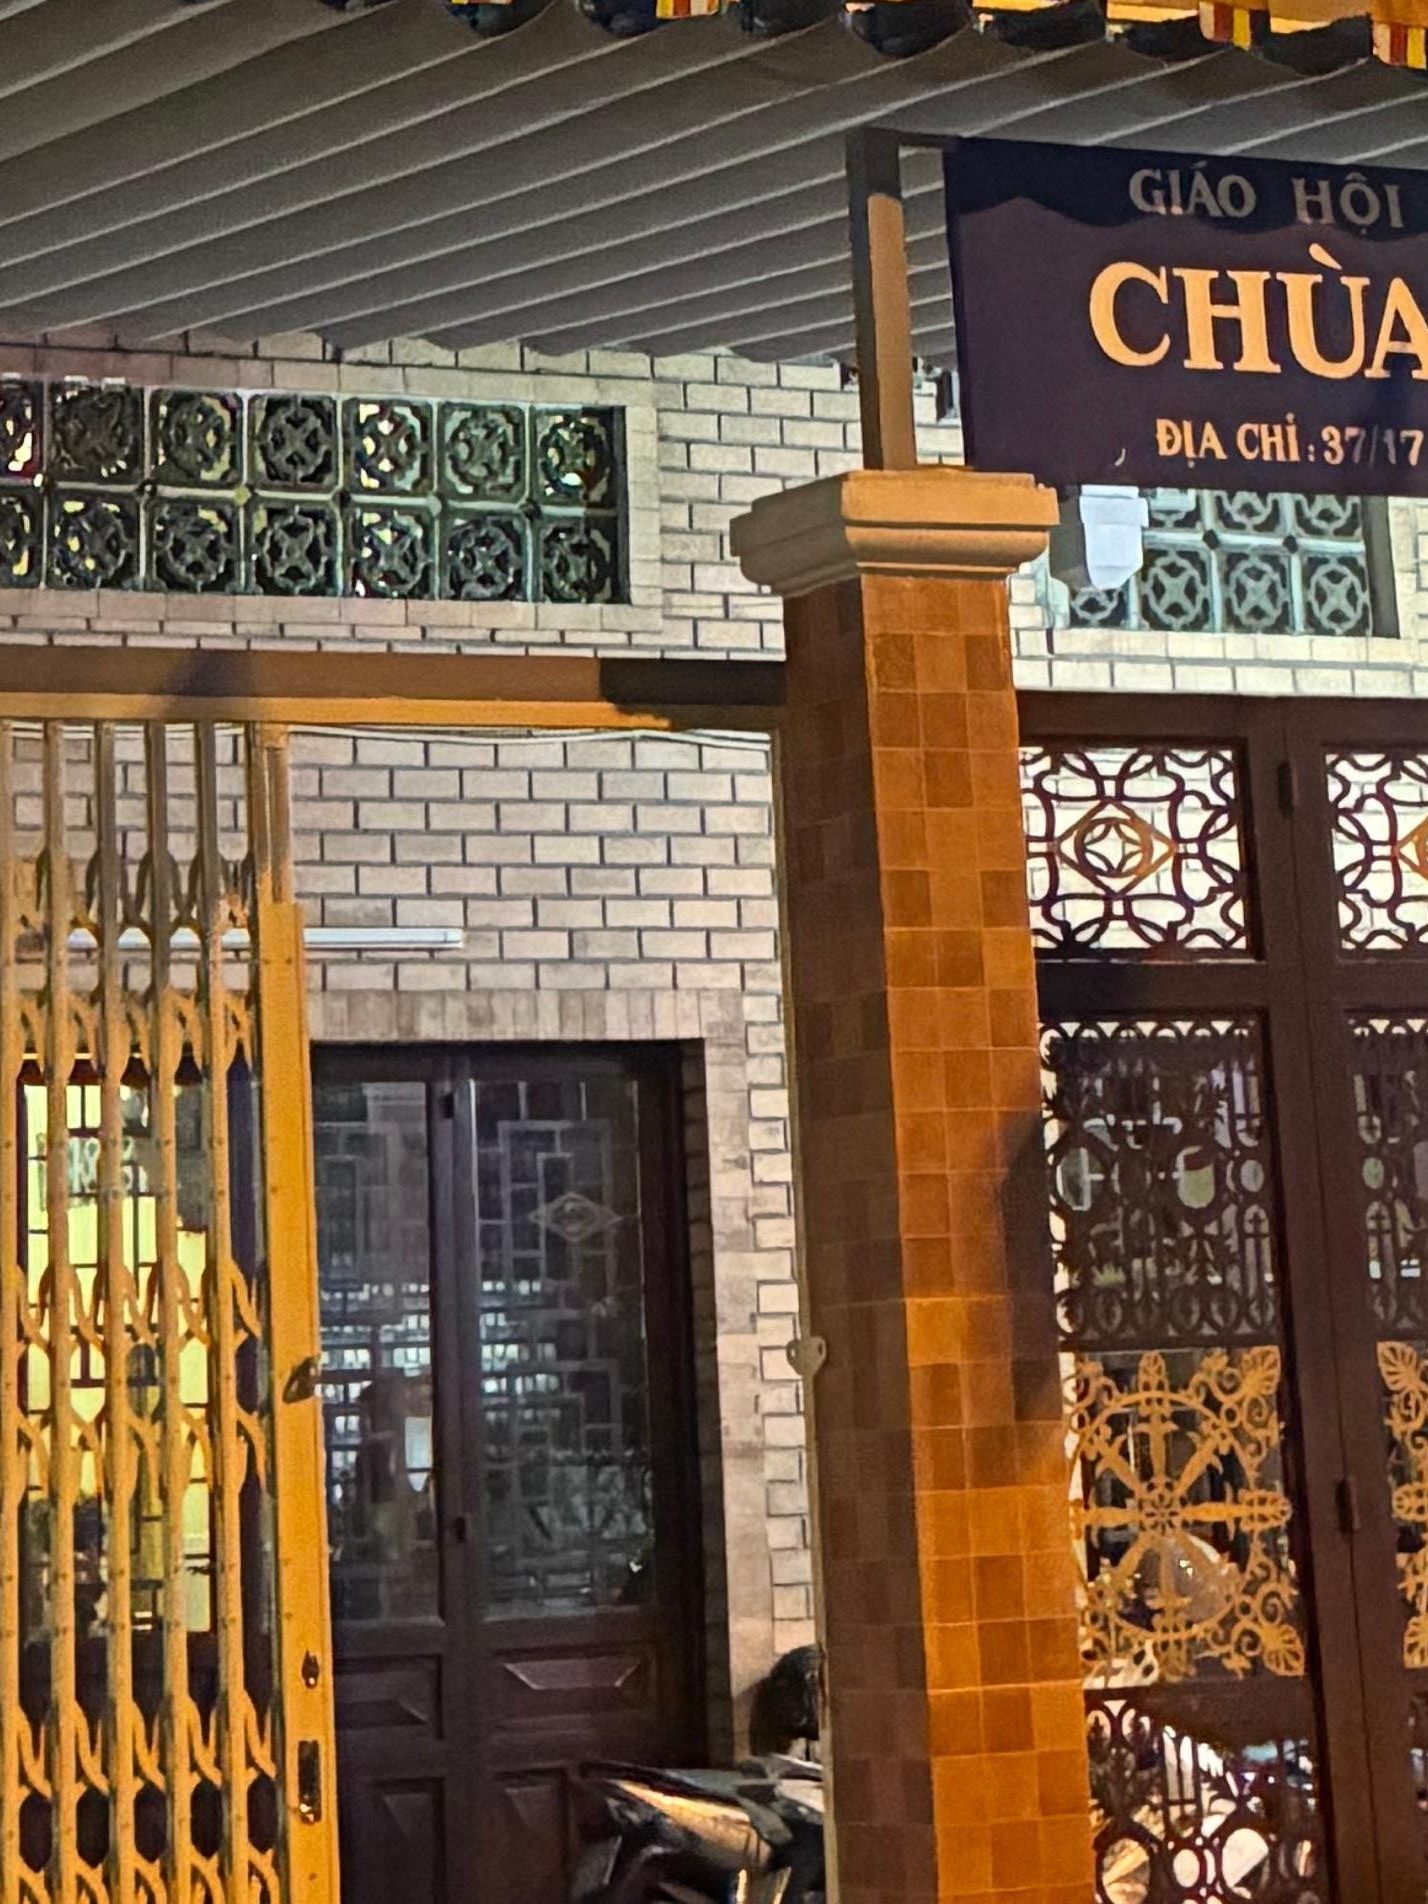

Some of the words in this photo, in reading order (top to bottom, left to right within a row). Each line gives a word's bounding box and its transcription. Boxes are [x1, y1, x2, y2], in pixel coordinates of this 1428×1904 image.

[1128, 160, 1256, 218] GIÁO
[1291, 171, 1404, 235] HỘI
[1155, 418, 1228, 468] ĐỊA
